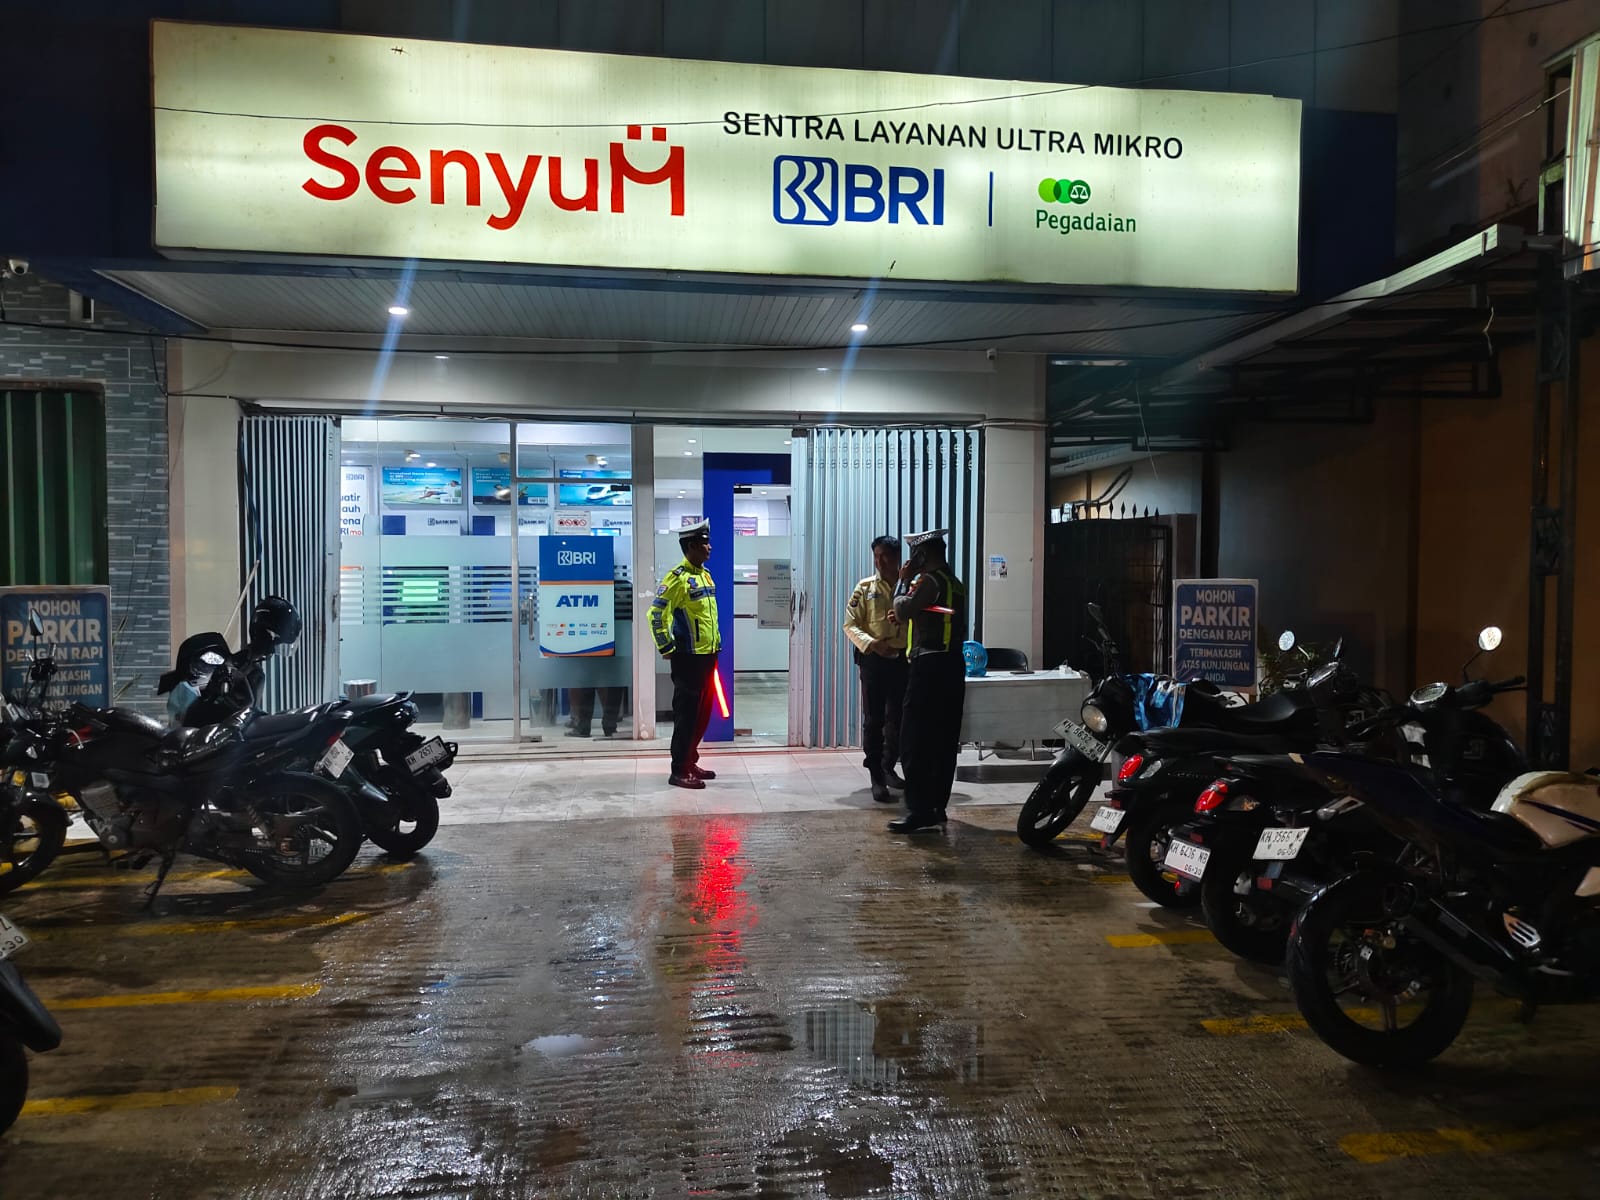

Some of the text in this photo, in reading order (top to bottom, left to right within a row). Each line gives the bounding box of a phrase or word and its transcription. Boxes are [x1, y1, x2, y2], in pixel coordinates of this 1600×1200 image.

[723, 111, 1183, 159] SENTRA LAYANAN ULTRA MIKRO
[844, 164, 945, 226] BRI
[1035, 209, 1137, 235] Pegadaian
[573, 551, 596, 565] BRI
[556, 594, 599, 608] ATM
[1195, 589, 1236, 603] MOHON
[1180, 605, 1251, 627] PARKIR
[1179, 628, 1252, 641] DENGAN RAPI
[71, 646, 104, 660] RAPI
[1190, 648, 1242, 658] TERIMAKASIH
[1182, 660, 1250, 671] ATAS KUNJUNGAN
[1204, 672, 1226, 682] ANDA
